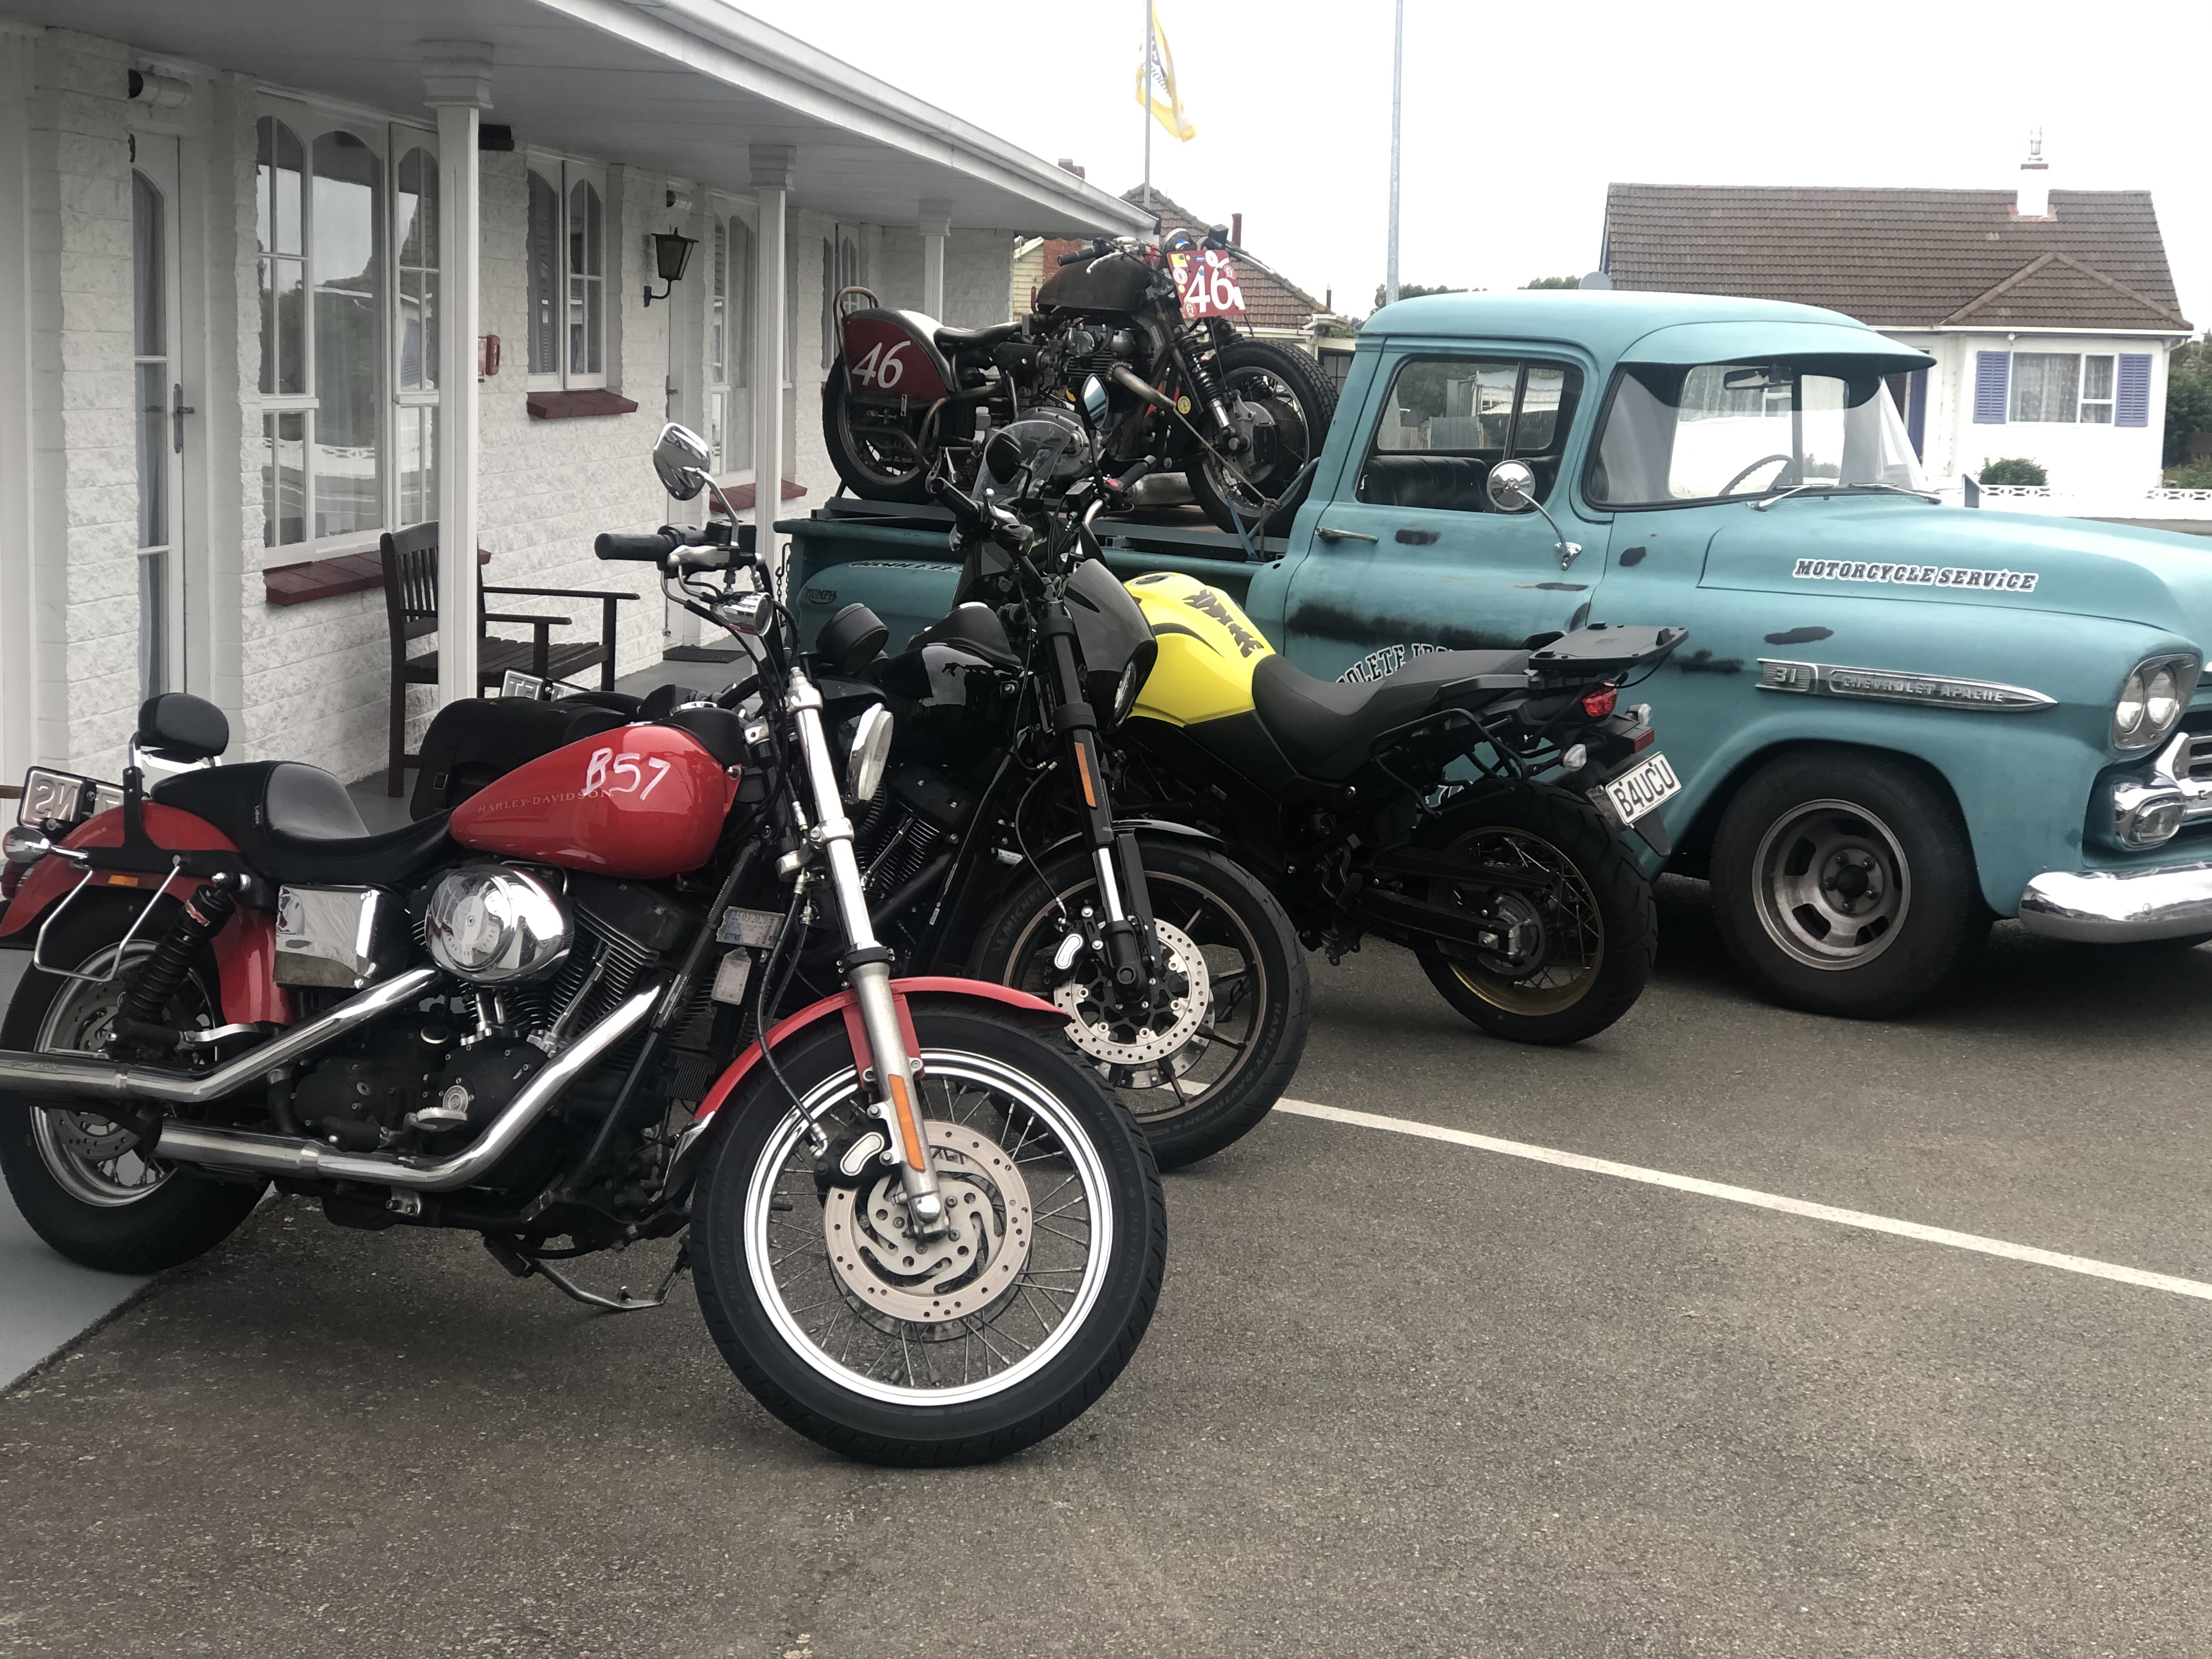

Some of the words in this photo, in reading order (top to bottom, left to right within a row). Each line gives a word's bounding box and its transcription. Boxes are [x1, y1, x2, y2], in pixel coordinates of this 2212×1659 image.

[1183, 257, 1234, 313] 46
[851, 340, 911, 388] 46
[1795, 558, 1937, 584] MOTORCYCLE
[1336, 644, 1406, 683] OLETE
[1774, 667, 1797, 684] 31
[1843, 675, 1935, 695] CHEVROLET
[1940, 684, 2004, 703] APACHE
[582, 747, 670, 801] B57
[1613, 759, 1675, 818] B4UCU
